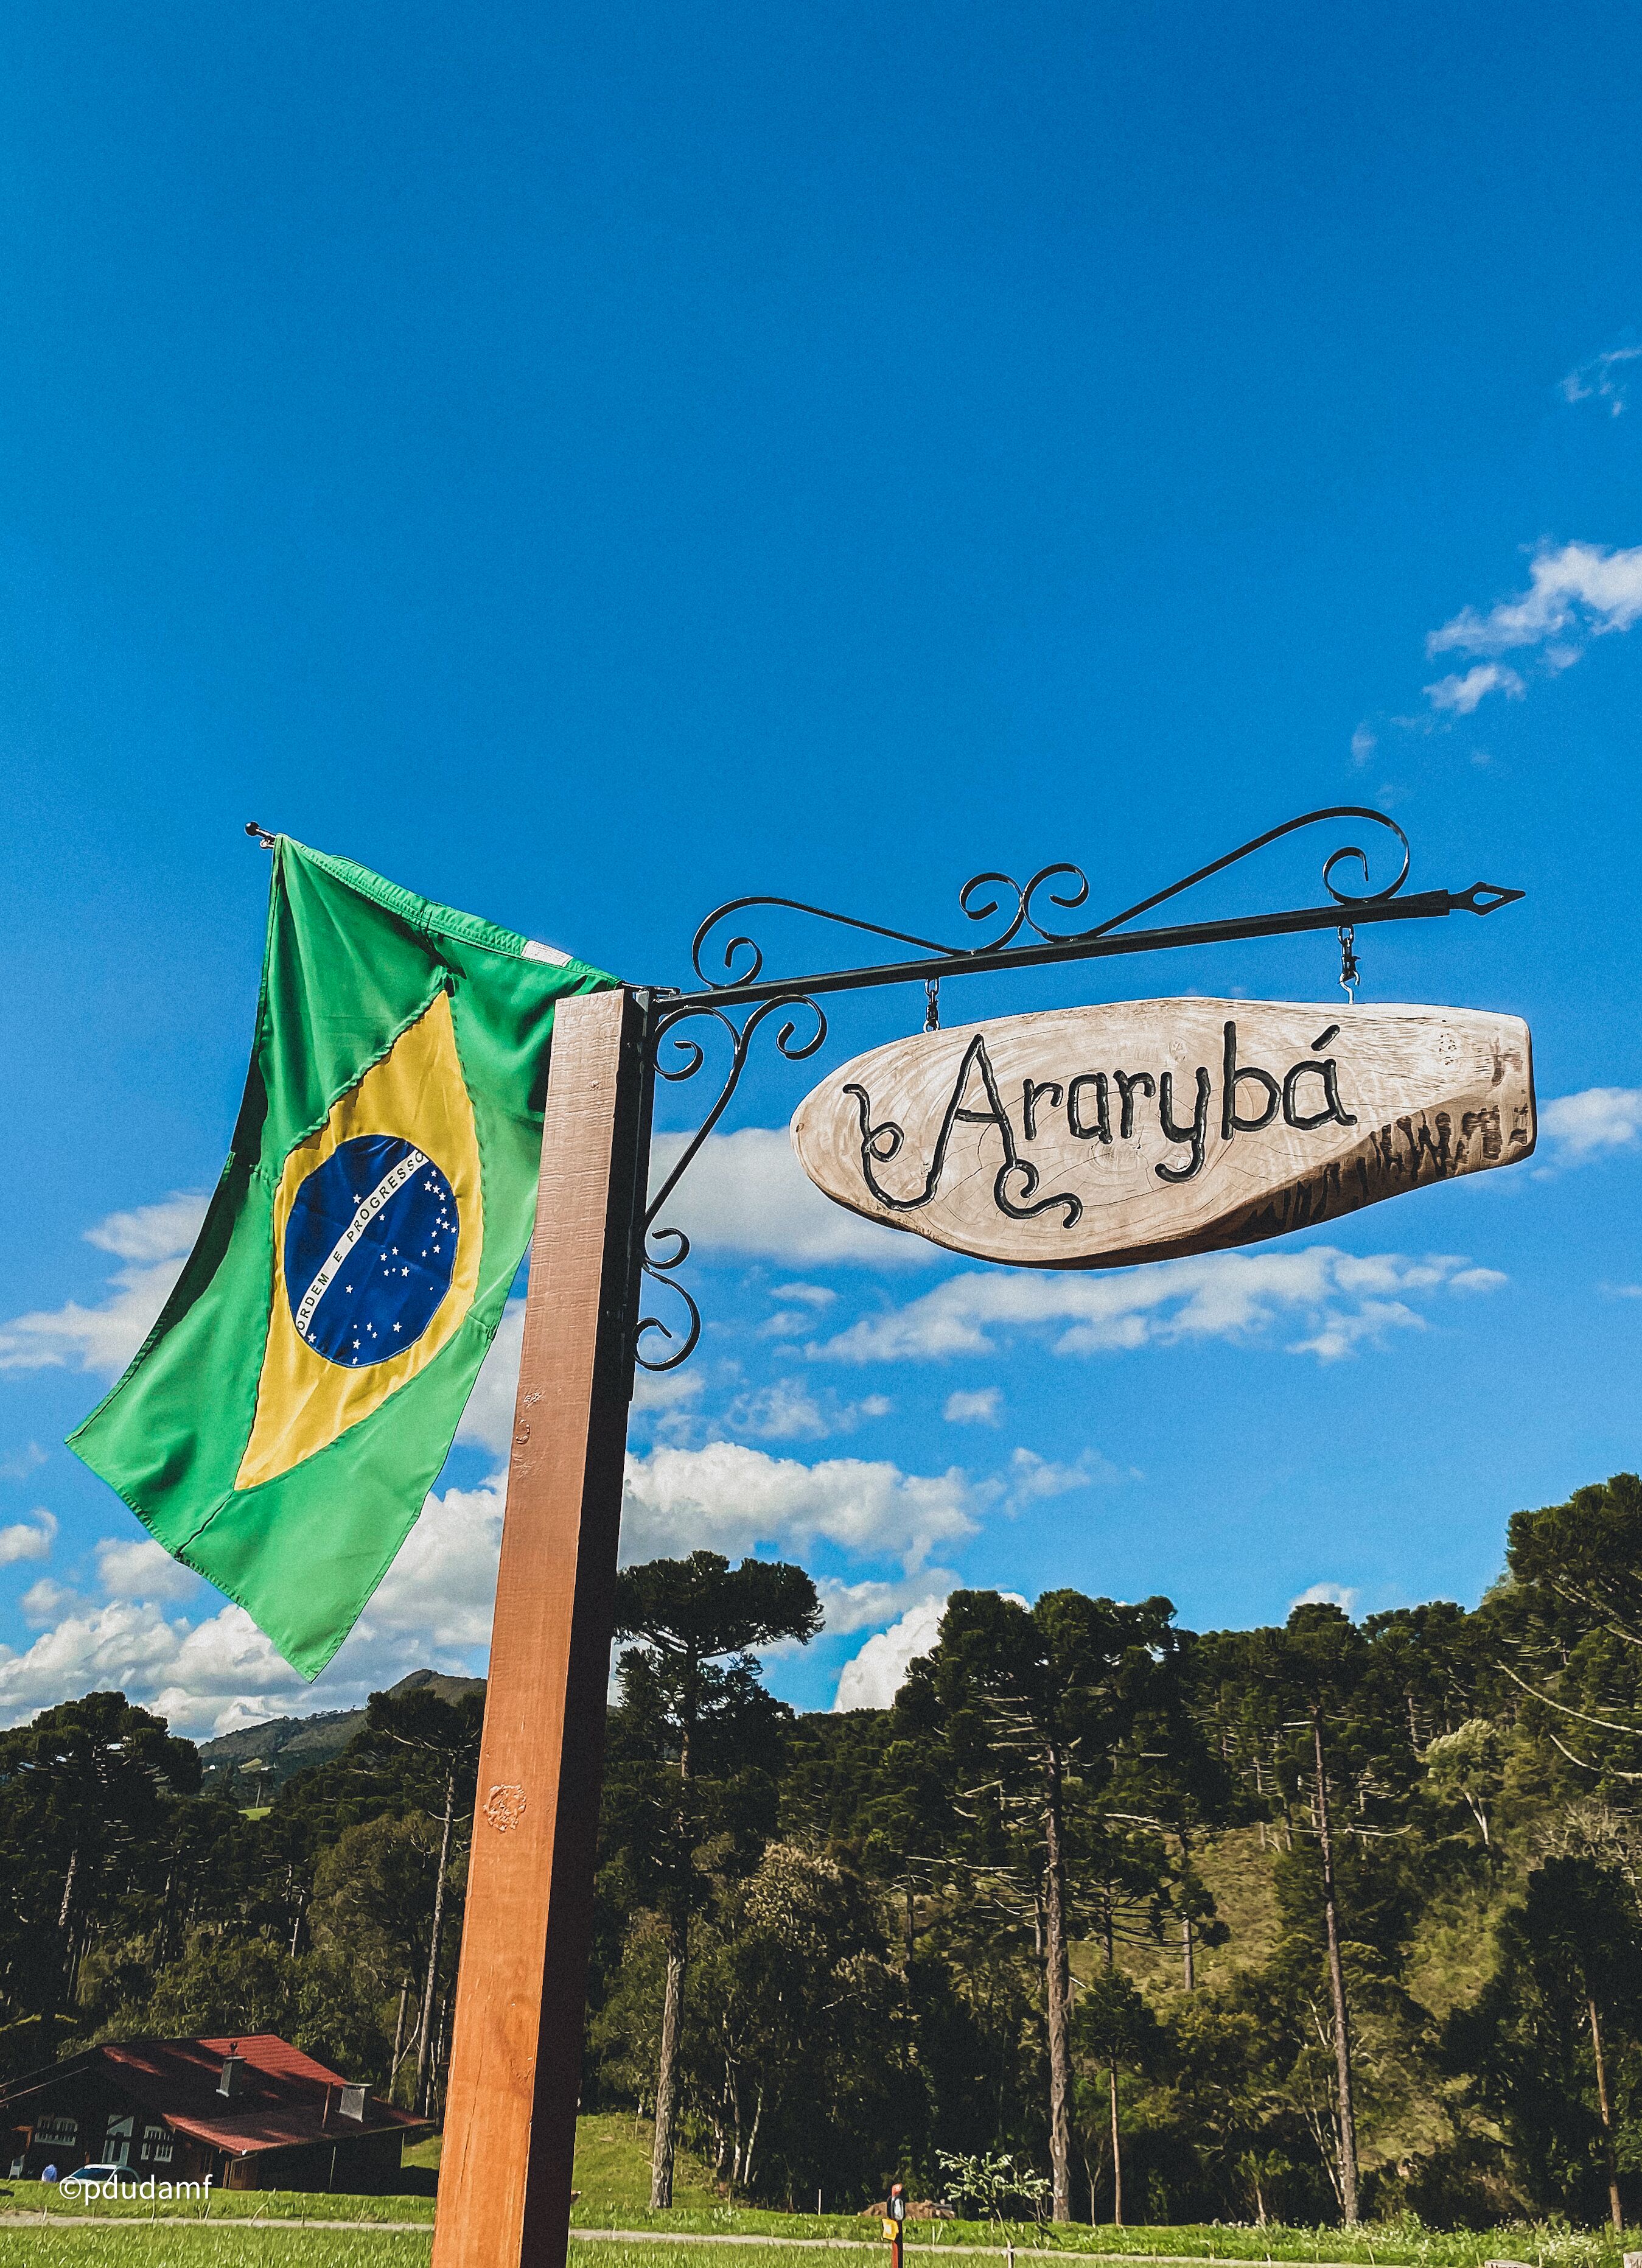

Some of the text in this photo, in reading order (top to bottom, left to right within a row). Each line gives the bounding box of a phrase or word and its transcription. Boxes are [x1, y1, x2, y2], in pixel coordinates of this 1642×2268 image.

[843, 1020, 1357, 1229] Ararybá
[297, 1151, 424, 1331] ORDEM E PROGRESSO
